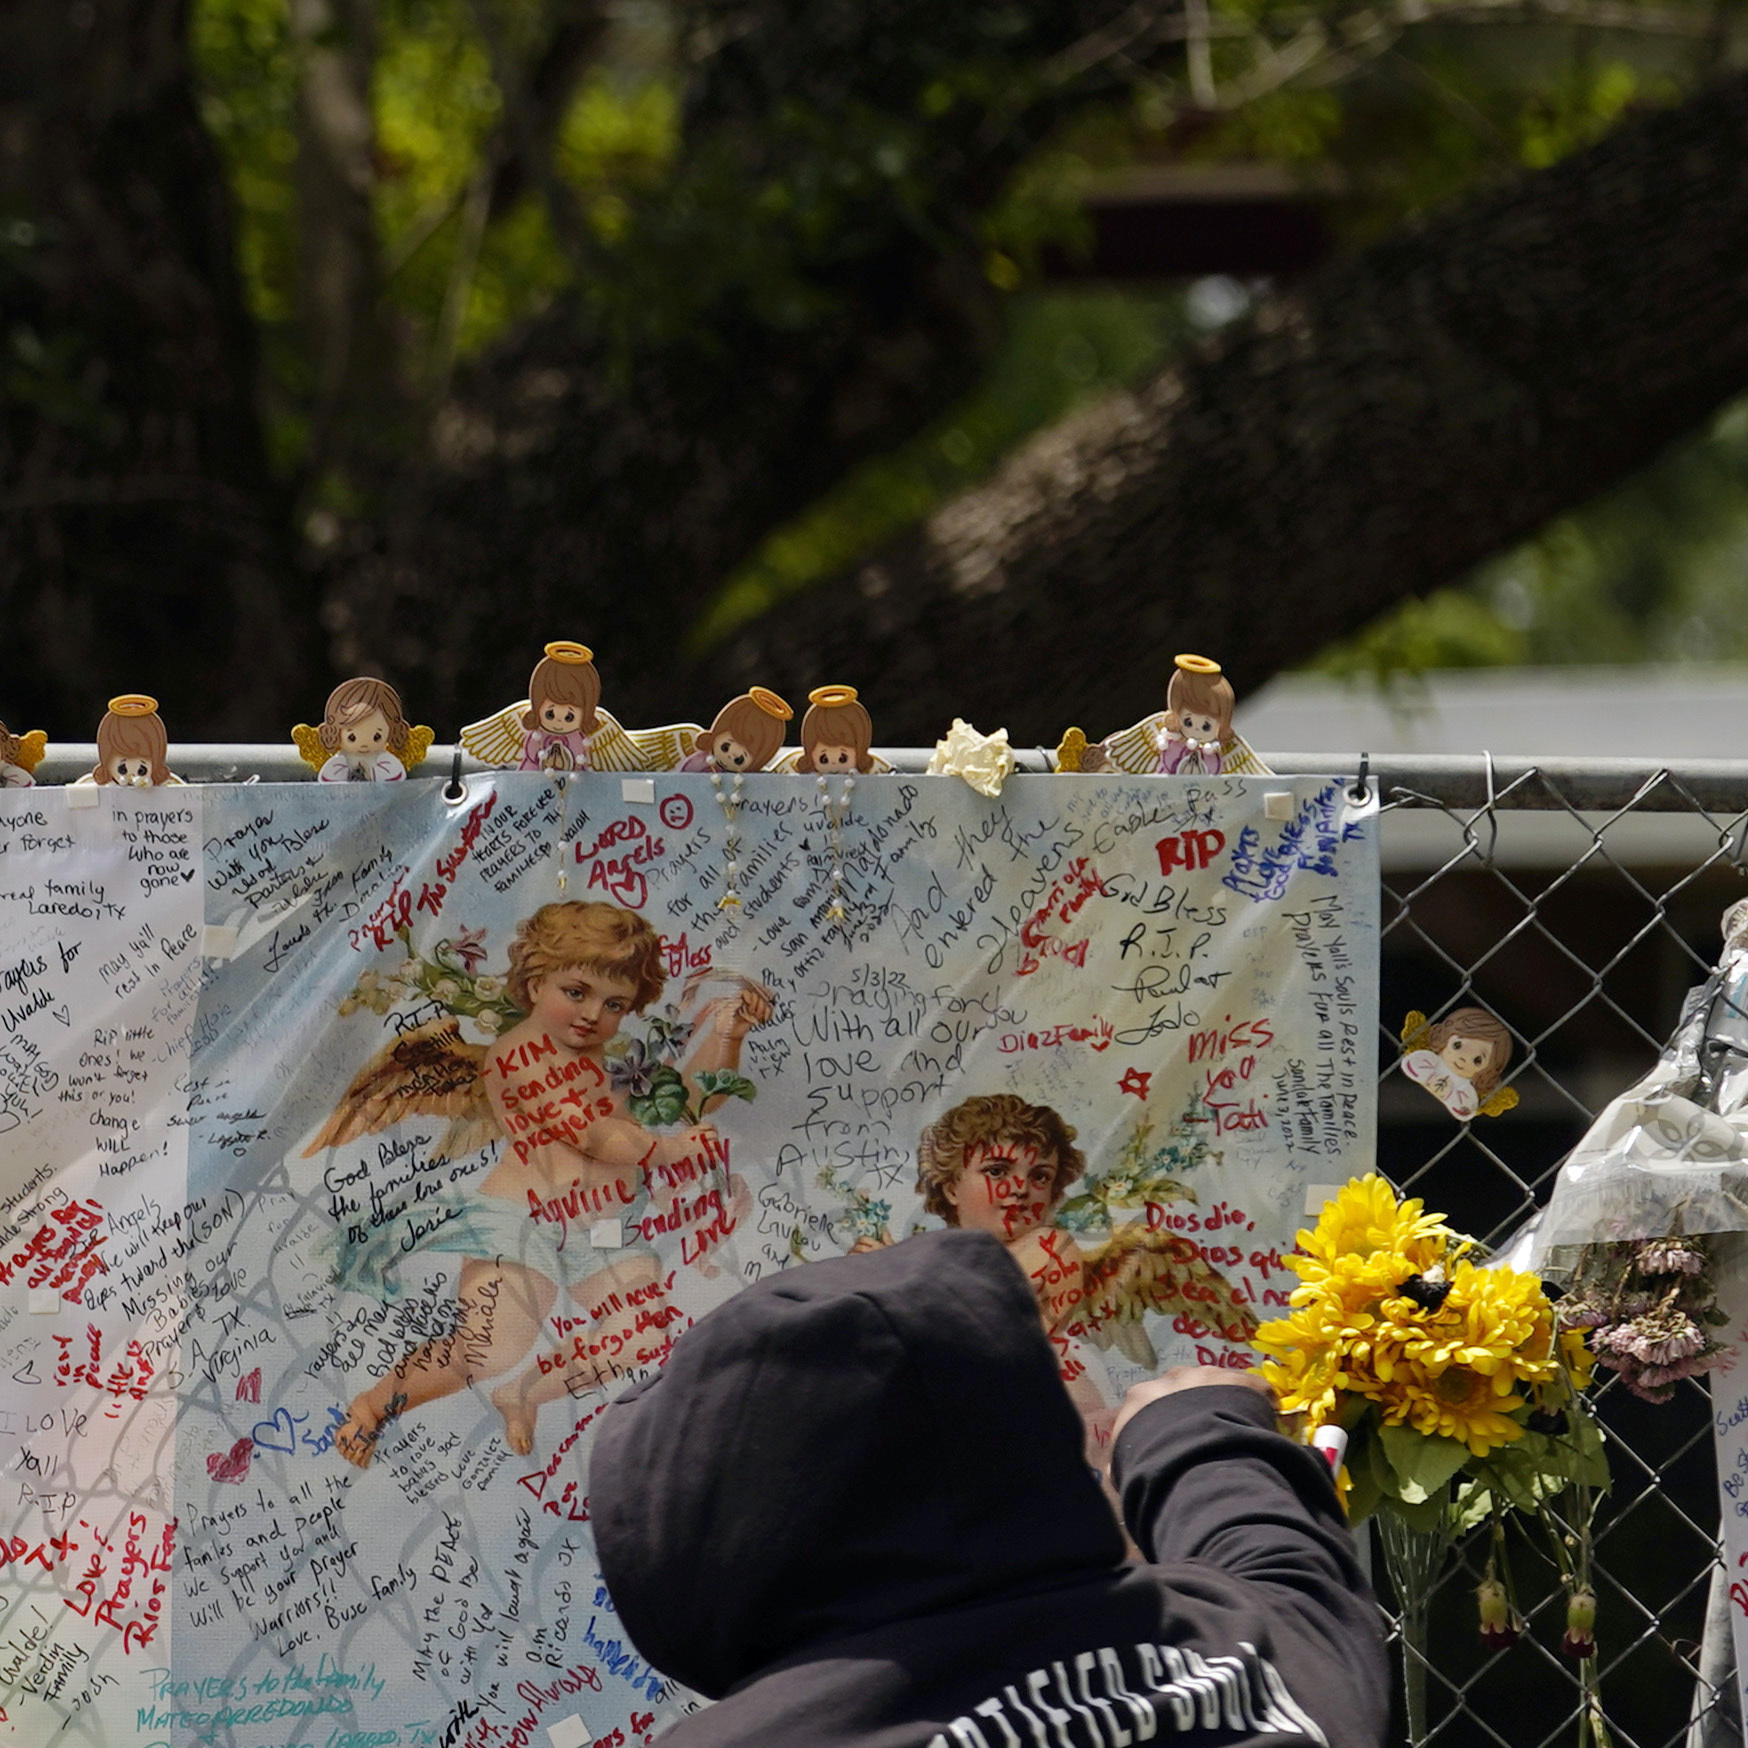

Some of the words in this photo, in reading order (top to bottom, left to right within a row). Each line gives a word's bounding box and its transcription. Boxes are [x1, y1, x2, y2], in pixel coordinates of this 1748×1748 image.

[112, 808, 131, 823] in
[134, 809, 194, 831] prayers
[122, 830, 139, 844] to
[142, 830, 188, 846] those
[1155, 829, 1226, 876] RIP
[147, 863, 180, 876] now
[163, 848, 191, 862] are
[139, 873, 181, 897] gone
[699, 865, 721, 891] all
[666, 892, 694, 917] for
[924, 865, 1000, 970] entered
[715, 922, 741, 950] and
[59, 941, 85, 974] for
[792, 1012, 874, 1048] With
[884, 1008, 924, 1039] all
[805, 1049, 881, 1079] love
[58, 1087, 85, 1103] this
[807, 1080, 953, 1119] support
[513, 1096, 614, 1165] prayers
[792, 1106, 892, 1138] from
[95, 1137, 131, 1153] WILL
[99, 1141, 170, 1178] Happen!
[323, 1157, 371, 1196] God
[376, 1133, 433, 1169] Bless
[1146, 1199, 1201, 1234] Dios
[122, 1271, 198, 1323] Missing
[205, 1242, 238, 1273] our
[536, 1347, 568, 1375] be
[186, 1497, 249, 1539] Prayers
[255, 1490, 276, 1511] to
[288, 1479, 315, 1502] all
[324, 1472, 354, 1492] the
[245, 1523, 288, 1547] and
[294, 1498, 348, 1535] people
[314, 1526, 341, 1549] and
